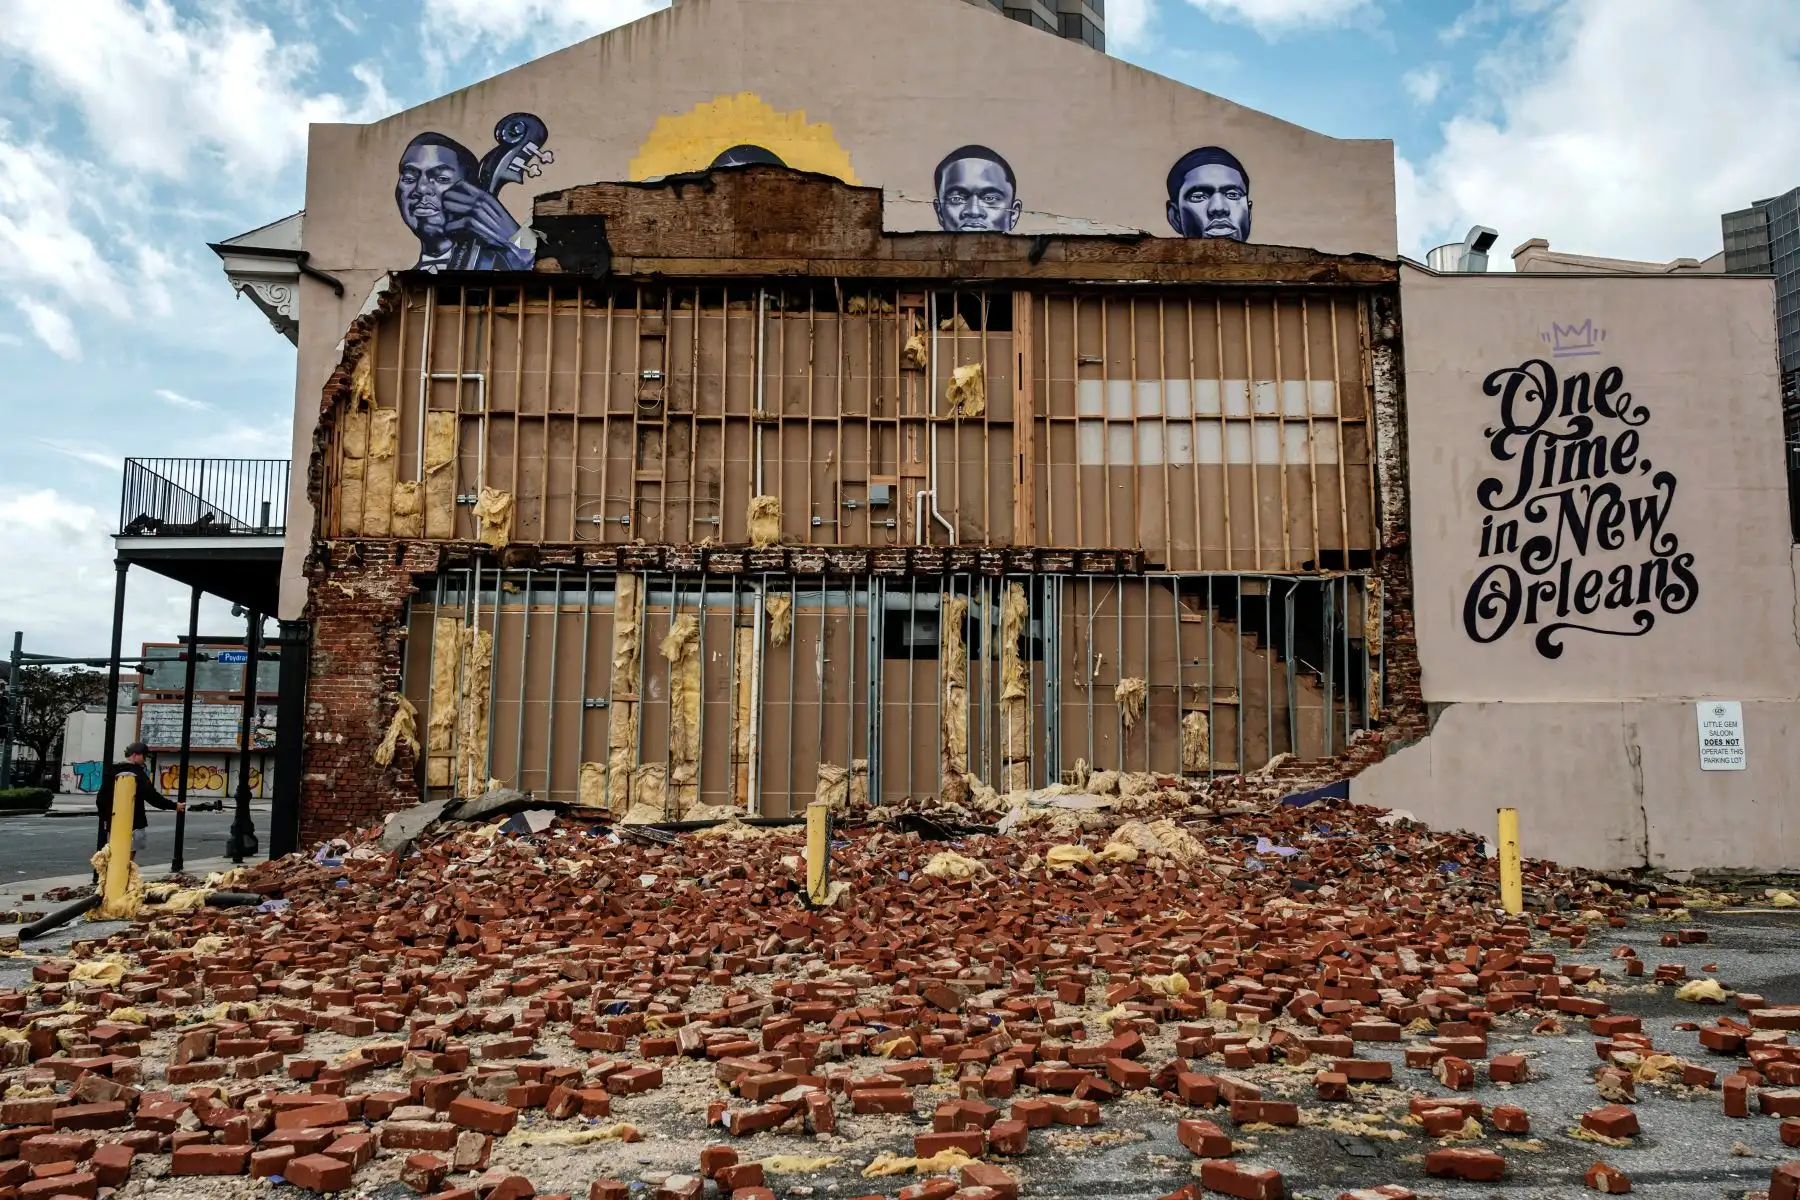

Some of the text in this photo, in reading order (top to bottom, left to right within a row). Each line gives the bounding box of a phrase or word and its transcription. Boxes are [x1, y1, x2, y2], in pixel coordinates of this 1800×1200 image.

[1482, 359, 1650, 434] One
[1477, 415, 1652, 511] Time,
[1478, 471, 1677, 575] in New
[1463, 552, 1699, 644] Orleans
[1704, 738, 1740, 746] DOES NOT
[1709, 729, 1734, 737] SALOON
